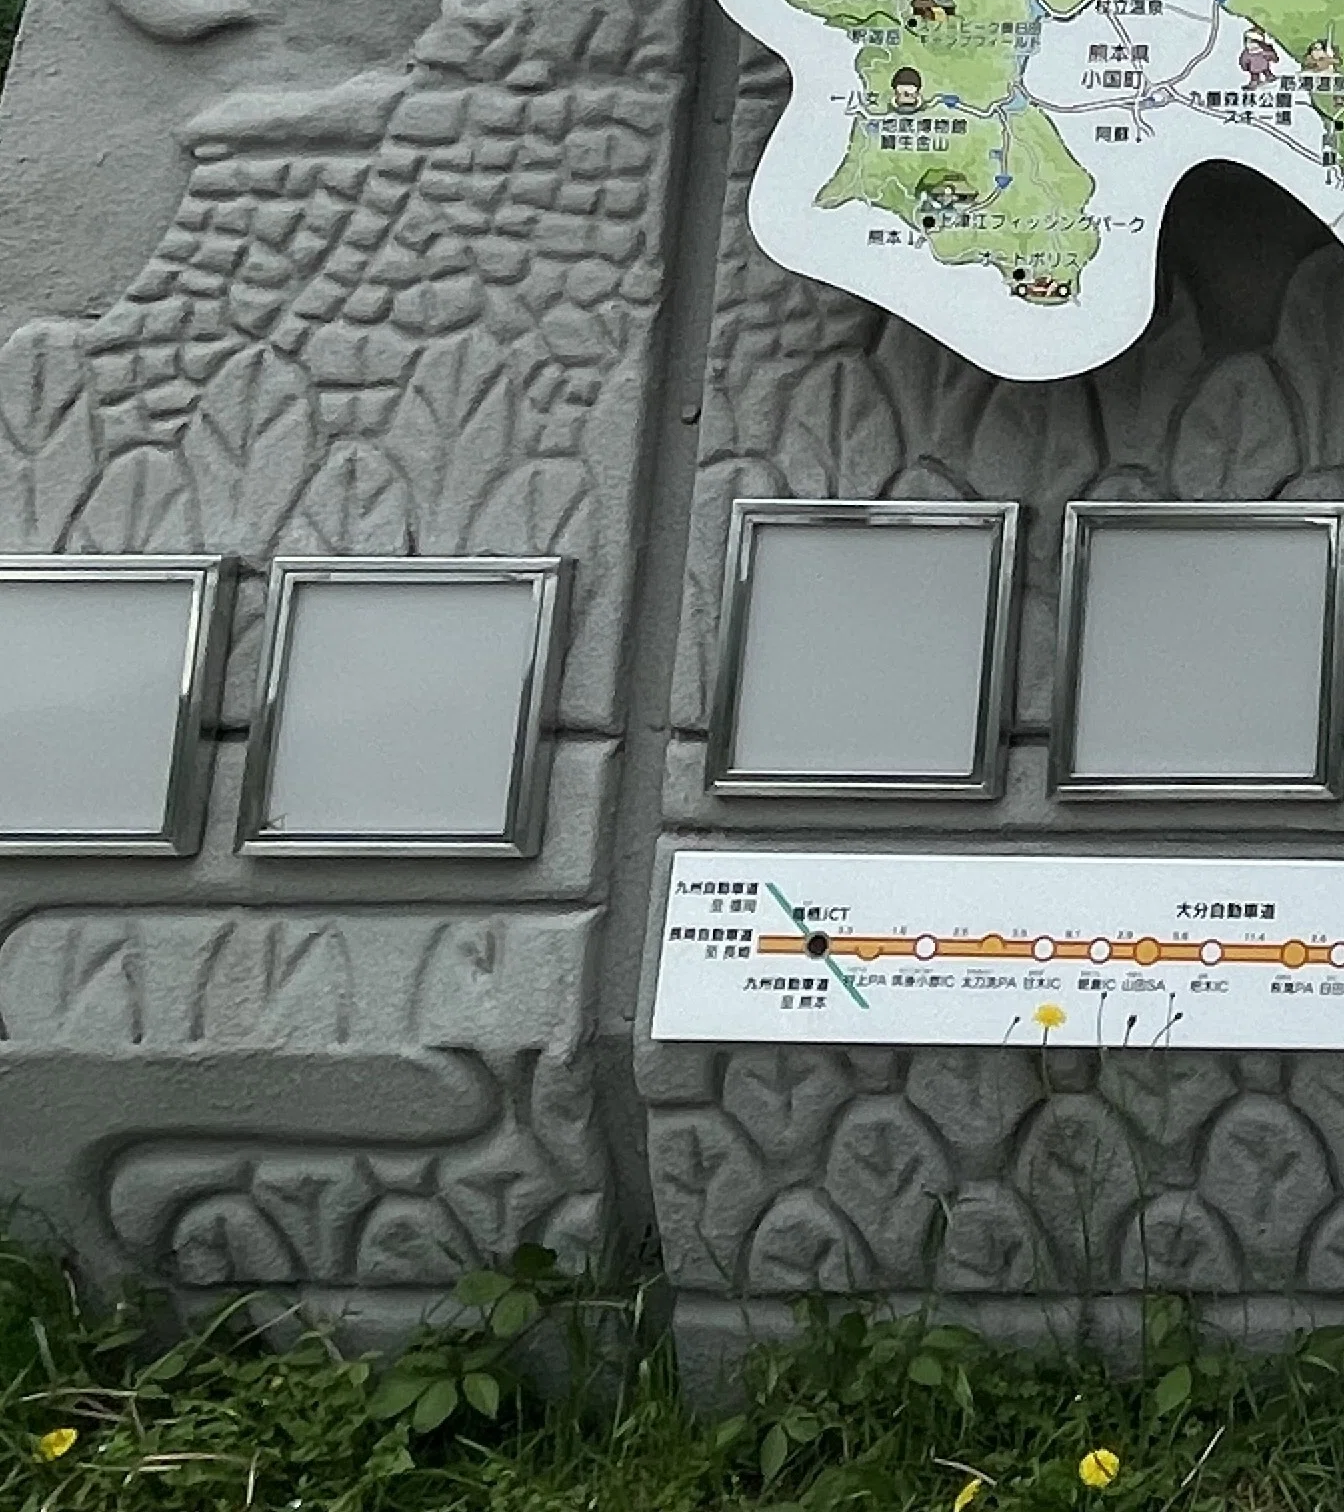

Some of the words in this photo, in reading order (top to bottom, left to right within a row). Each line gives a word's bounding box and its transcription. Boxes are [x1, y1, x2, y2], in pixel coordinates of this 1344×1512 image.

[1082, 71, 1144, 88] 小国町
[1176, 903, 1276, 921] 大分自動車道
